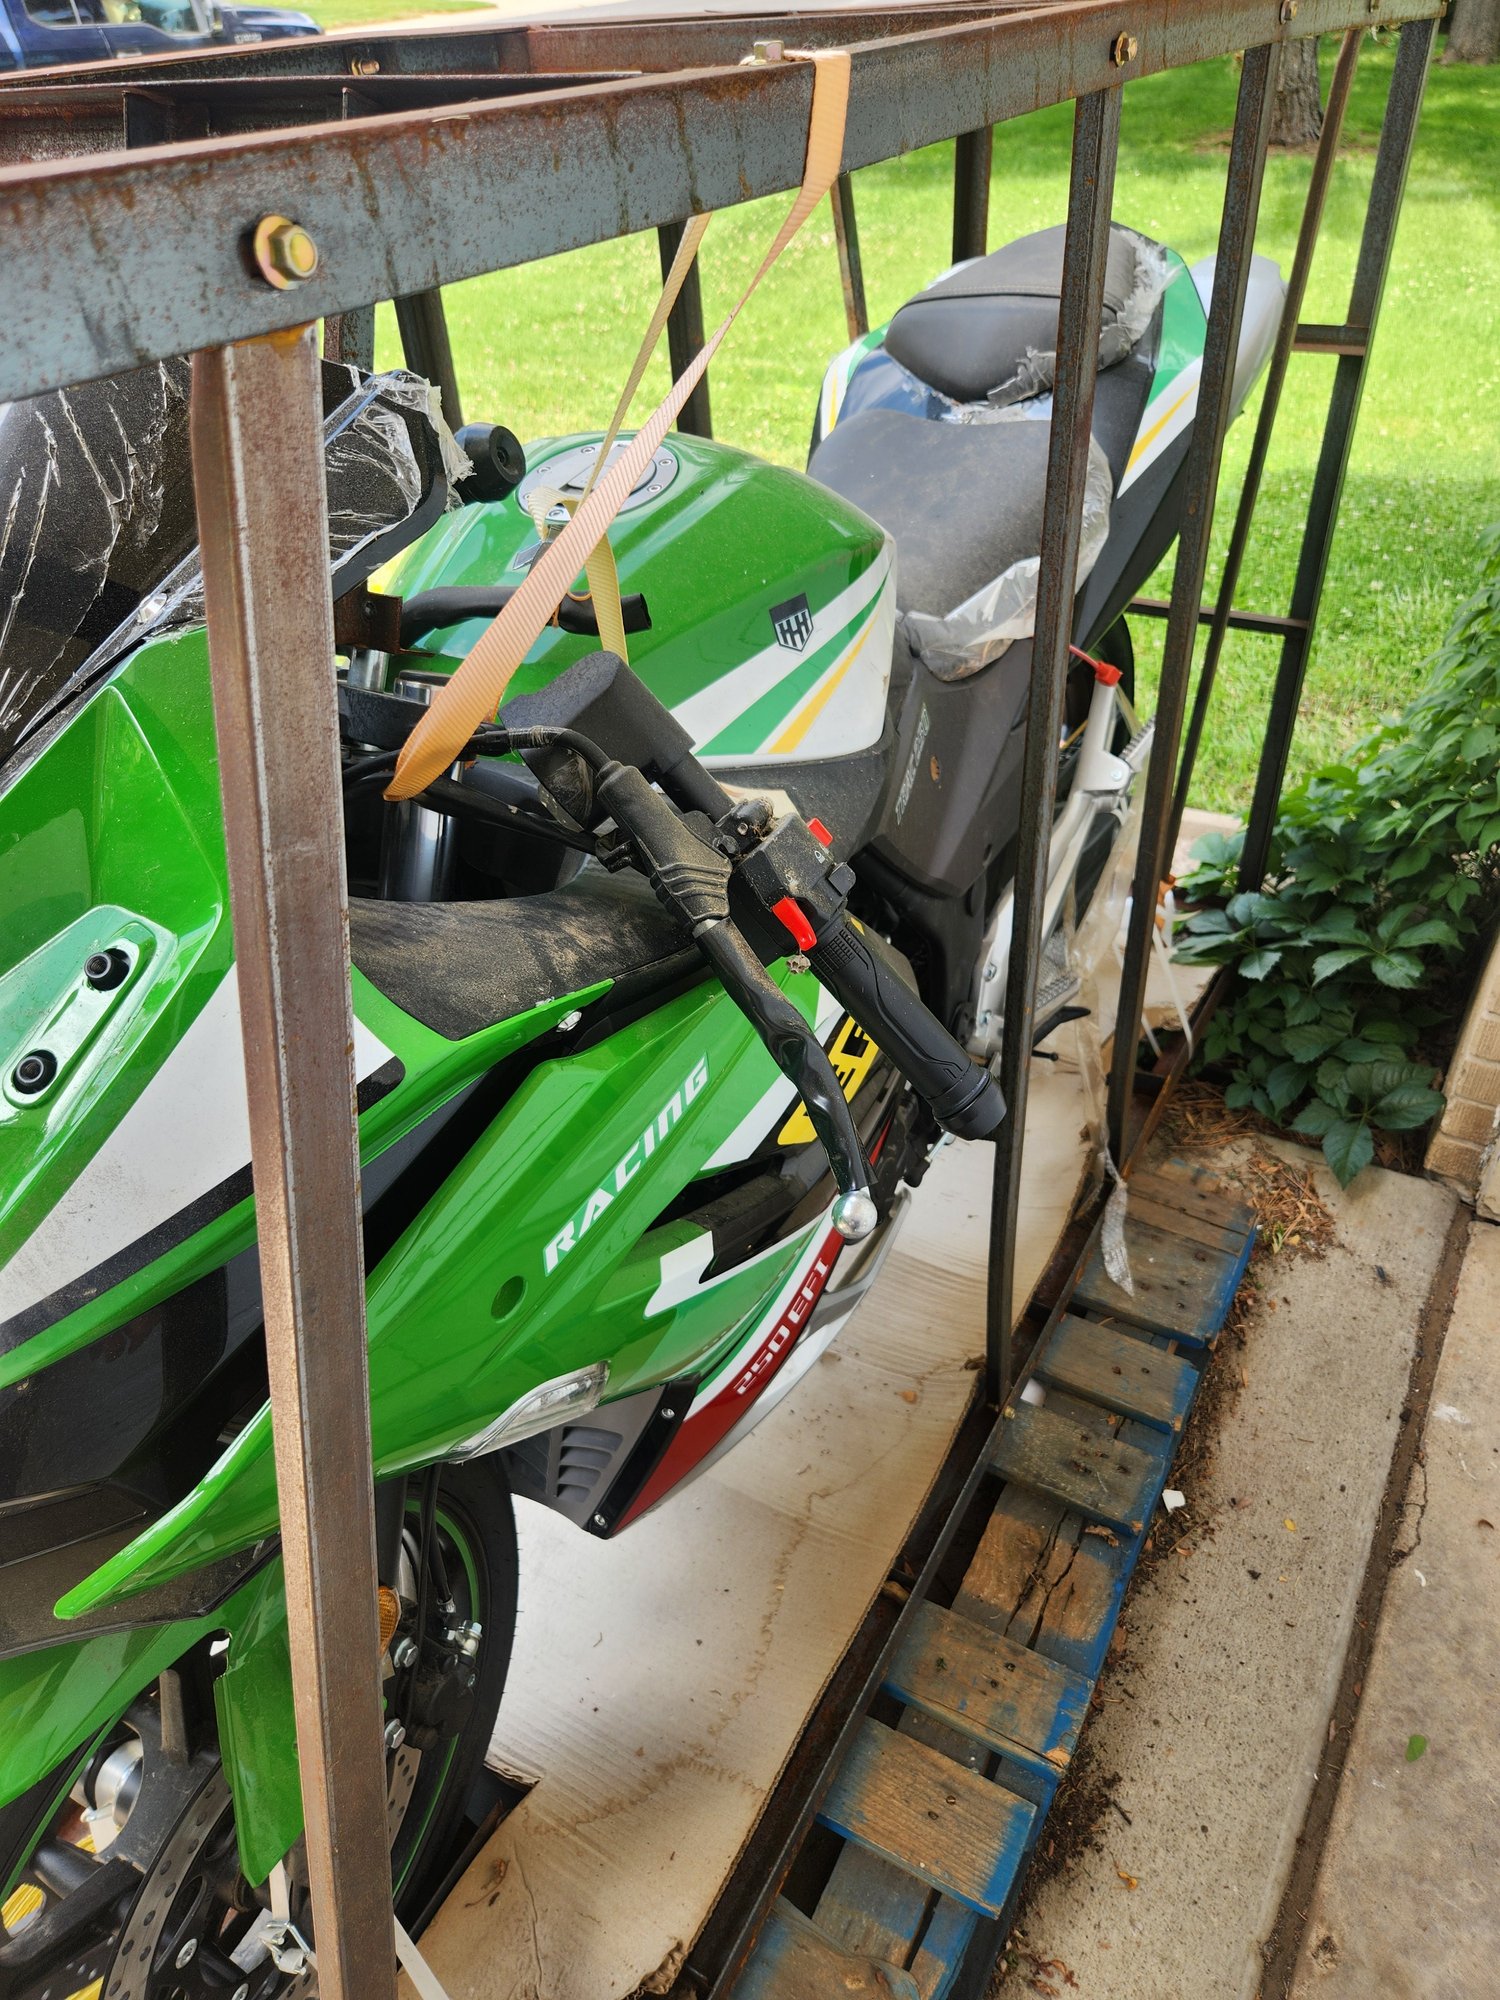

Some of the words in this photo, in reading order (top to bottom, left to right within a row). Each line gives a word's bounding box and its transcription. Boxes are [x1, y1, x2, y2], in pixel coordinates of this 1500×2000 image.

[545, 1056, 709, 1274] RACING
[734, 1324, 790, 1395] 250
[788, 1257, 829, 1324] EFI
